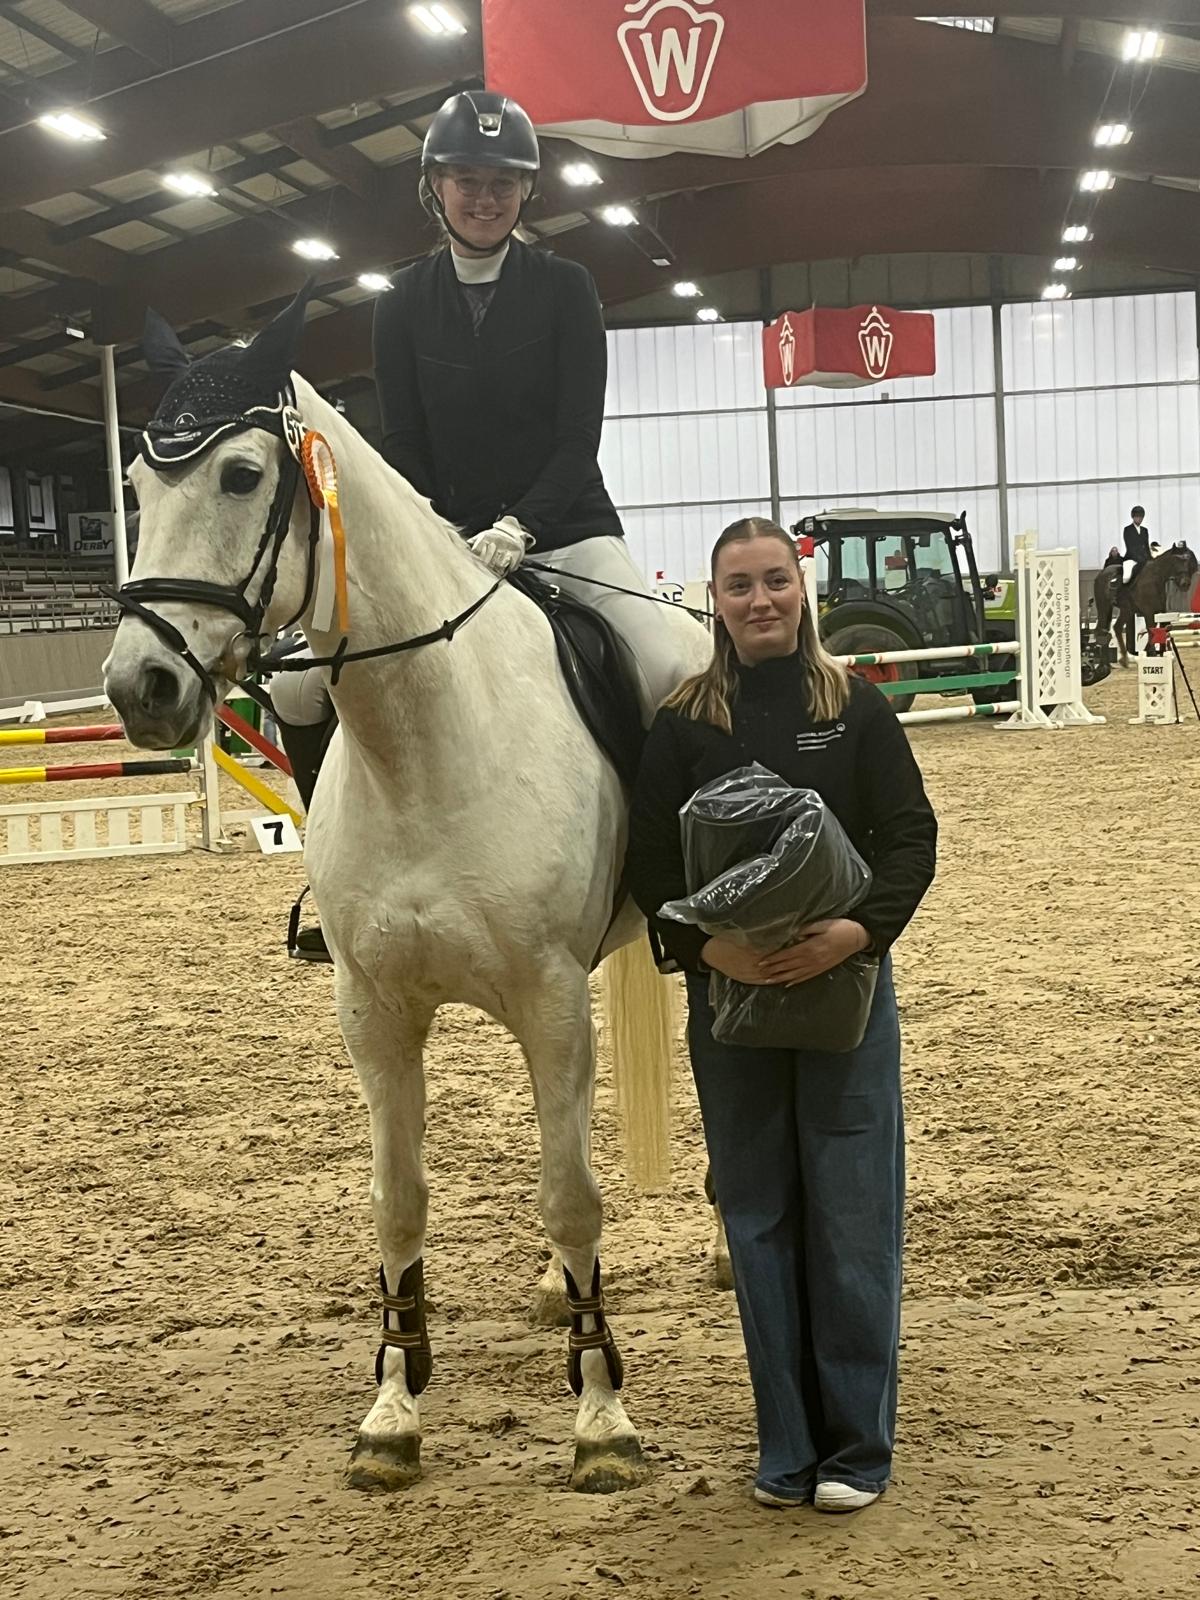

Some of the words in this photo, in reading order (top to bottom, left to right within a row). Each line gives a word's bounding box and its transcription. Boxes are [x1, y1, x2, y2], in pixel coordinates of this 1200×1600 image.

[639, 27, 702, 97] W
[865, 335, 886, 368] W
[1142, 666, 1164, 675] START
[262, 821, 284, 846] 7
